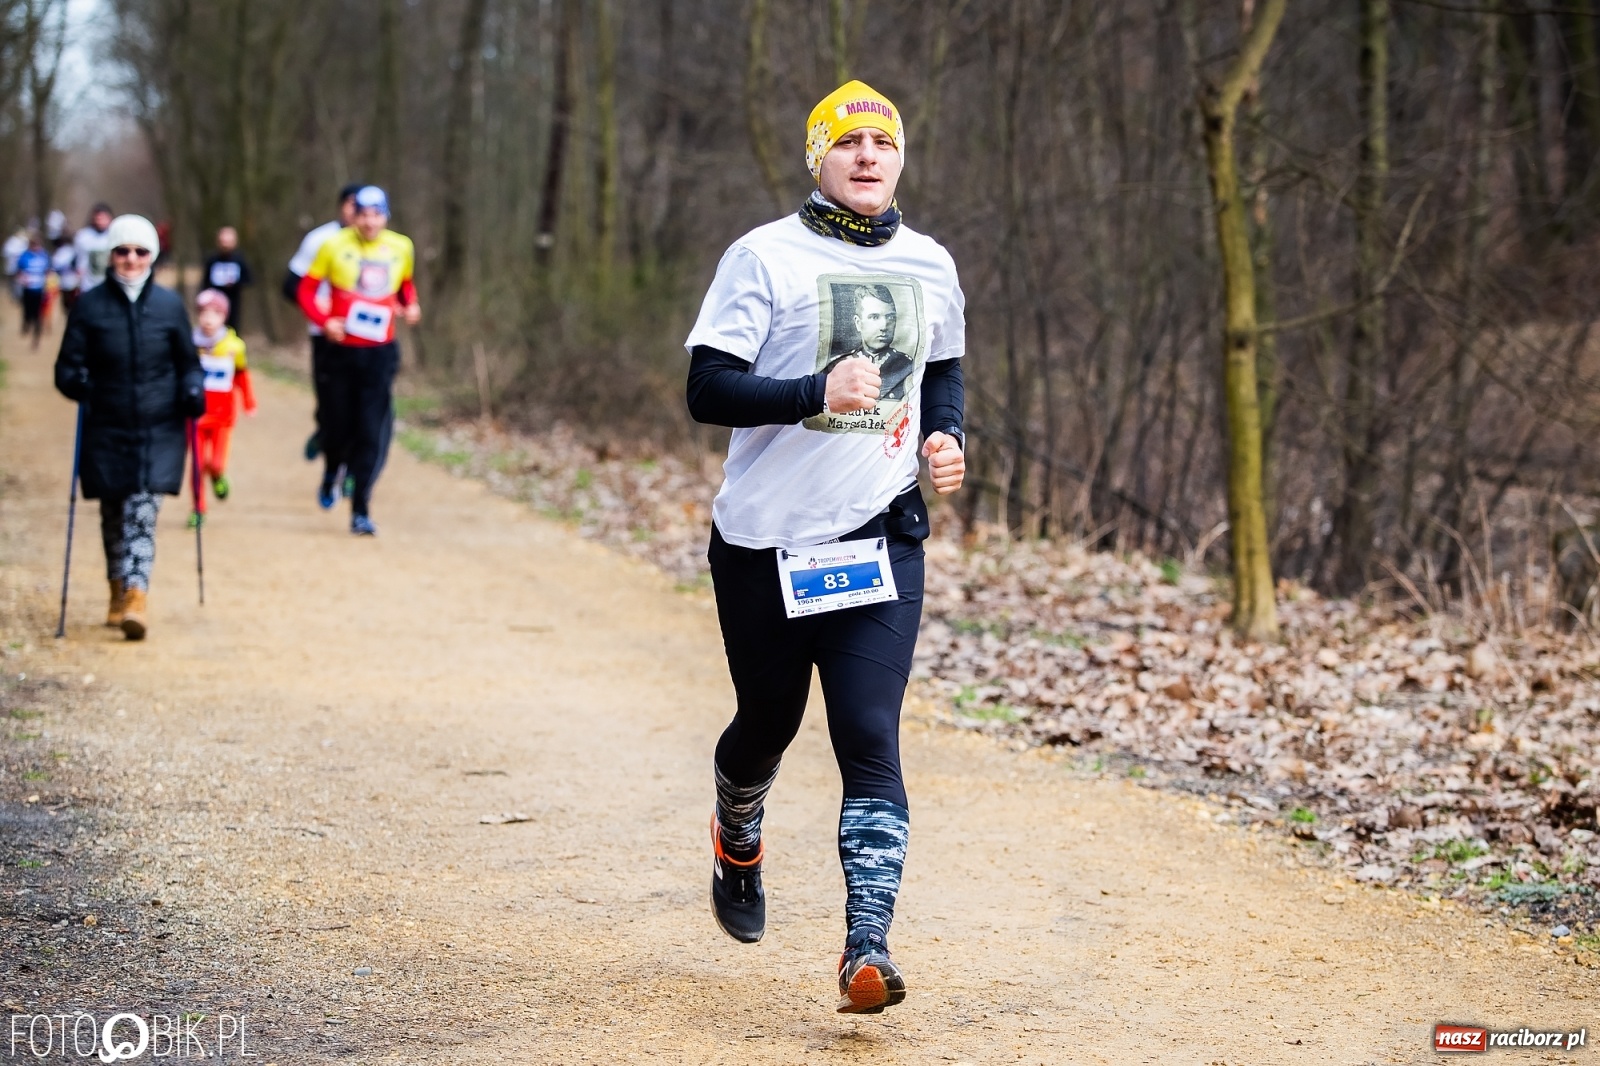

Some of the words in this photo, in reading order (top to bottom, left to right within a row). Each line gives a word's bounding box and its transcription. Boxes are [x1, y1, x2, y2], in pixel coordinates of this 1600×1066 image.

[845, 101, 892, 121] MARATON
[823, 572, 850, 590] 83
[797, 598, 814, 606] 1963
